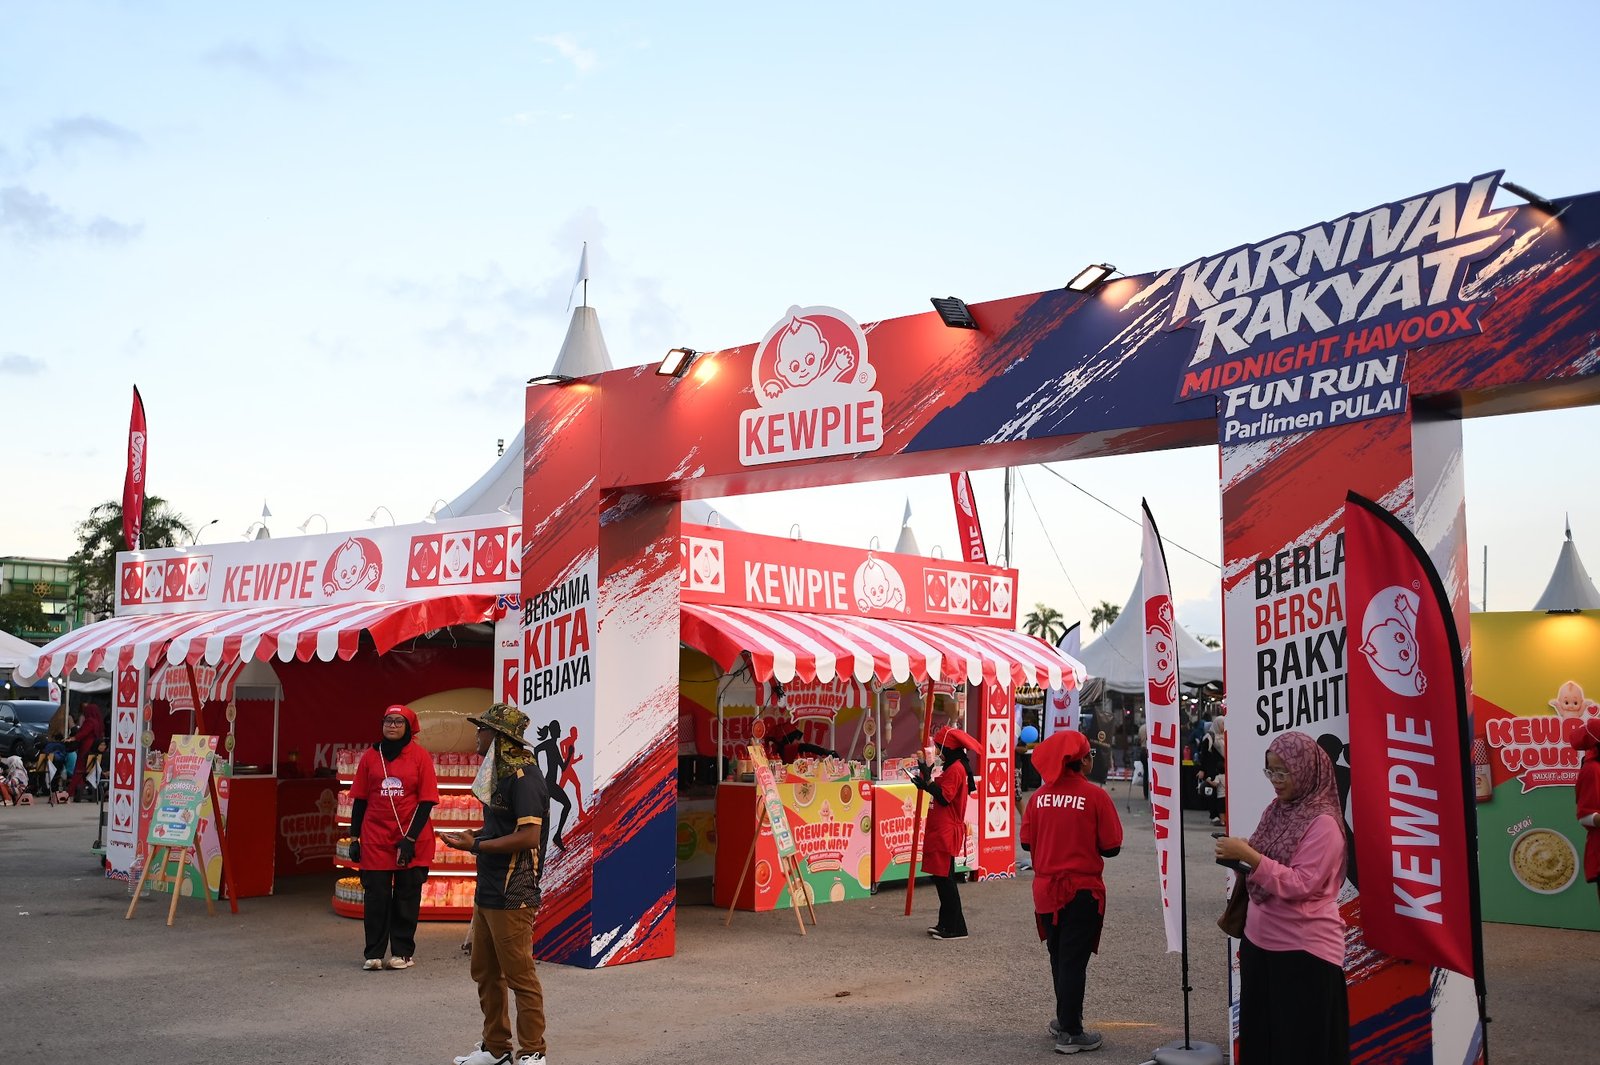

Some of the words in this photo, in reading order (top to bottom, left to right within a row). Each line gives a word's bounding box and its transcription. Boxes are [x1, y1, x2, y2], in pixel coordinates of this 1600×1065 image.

[1169, 176, 1511, 325] KARNIVAL
[1188, 234, 1506, 367] RAKYAT
[1180, 336, 1340, 398] MIDNIGHT
[1343, 304, 1477, 354] HAVOOX
[1223, 376, 1304, 418] FUN
[1309, 354, 1398, 399] RUN
[745, 400, 875, 456] KEWPIE
[1225, 409, 1323, 442] Parlimen
[1329, 388, 1402, 422] PULAI
[222, 560, 318, 603] KEWPIE
[524, 573, 590, 626] BERSAMA
[743, 560, 849, 610] KEWPIE
[523, 607, 590, 675] KITA
[523, 654, 591, 706] BERJAYA
[786, 693, 817, 707] YOUR
[1256, 672, 1349, 737] SEJAHT
[1503, 746, 1578, 769] YOUR
[380, 789, 404, 797] KEWPIE
[1036, 794, 1086, 811] KEWPIE
[1386, 713, 1443, 924] KEWPIE
[794, 822, 841, 841] KEWPIE
[842, 823, 853, 838] IT
[800, 840, 827, 855] YOUR
[827, 839, 849, 851] WAY
[1506, 816, 1533, 836] Serai
